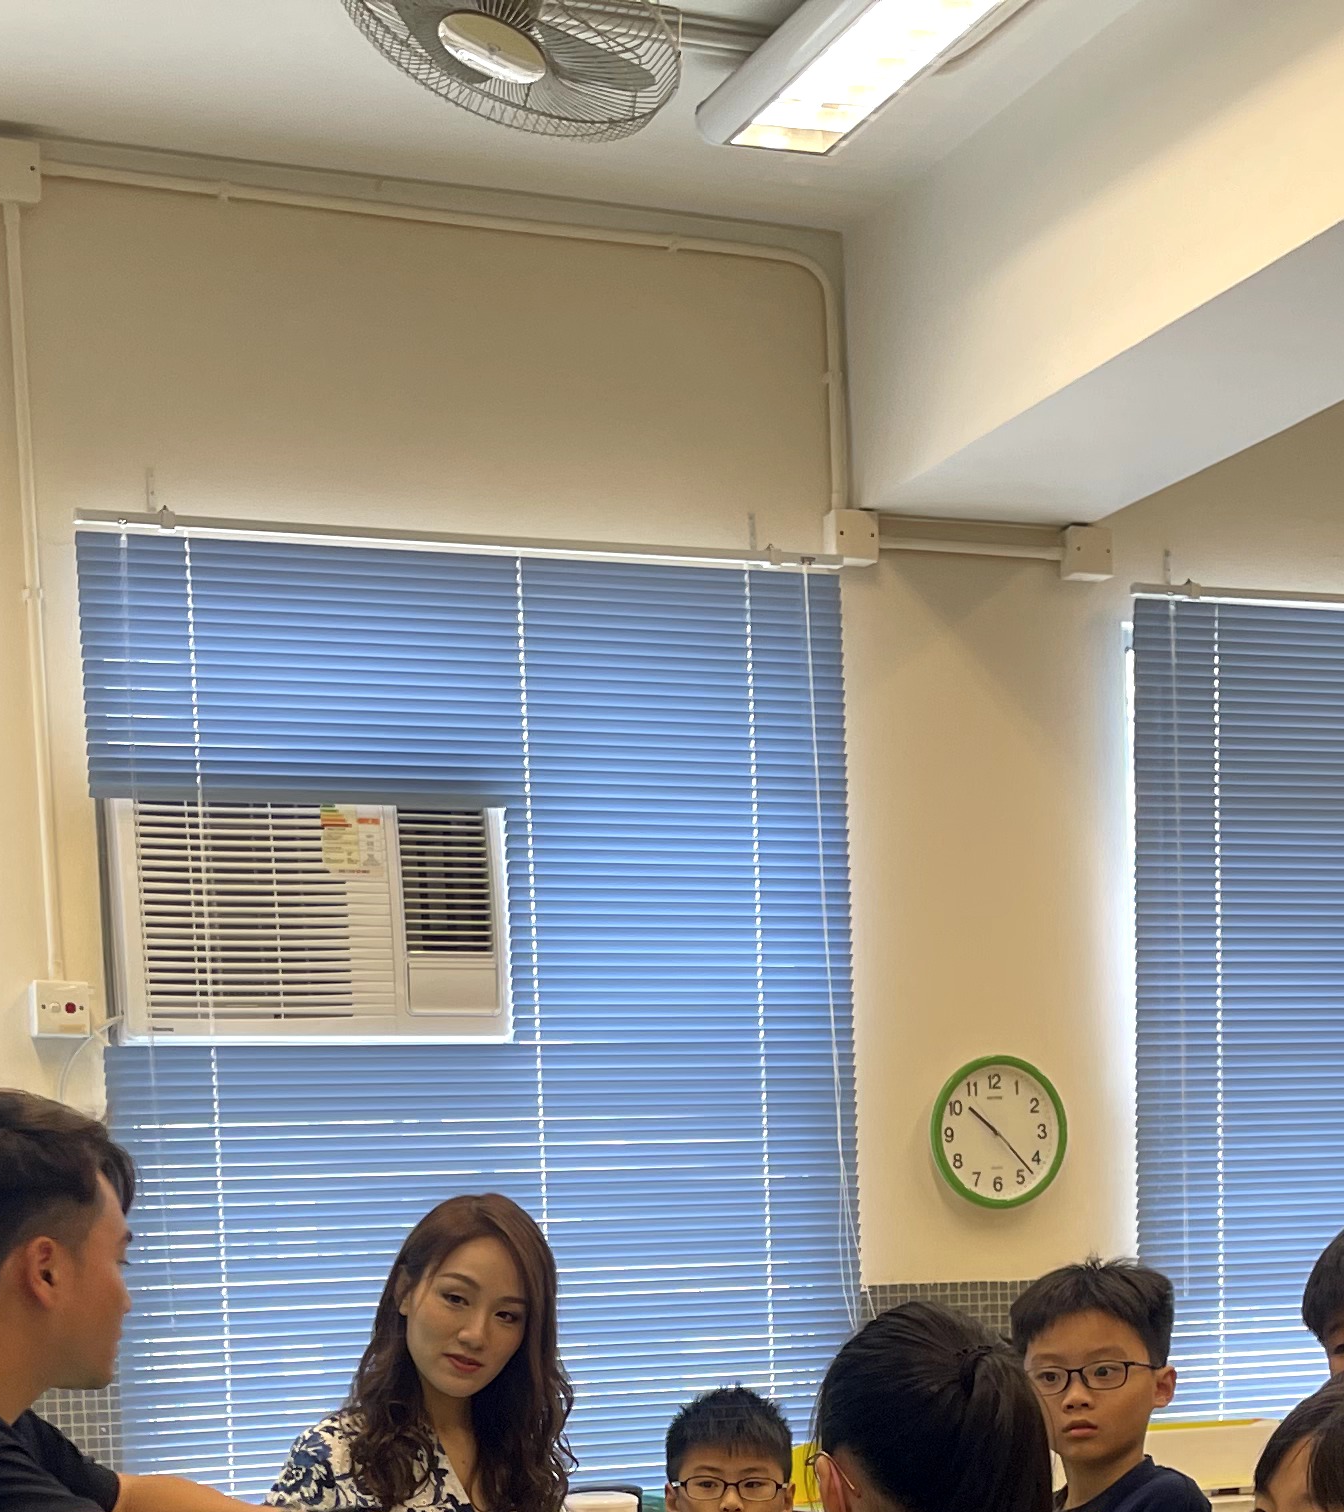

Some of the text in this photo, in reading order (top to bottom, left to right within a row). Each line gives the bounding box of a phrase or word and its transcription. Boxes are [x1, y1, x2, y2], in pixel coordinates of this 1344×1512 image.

[966, 1081, 978, 1097] 11
[987, 1073, 1002, 1090] 12
[1014, 1079, 1019, 1096] 1
[948, 1100, 963, 1116] 10
[1029, 1097, 1040, 1114] 2
[944, 1126, 954, 1143] 9
[1037, 1123, 1048, 1140] 3
[952, 1153, 963, 1169] 8
[1031, 1150, 1042, 1165] 4
[972, 1171, 982, 1187] 7
[992, 1176, 1003, 1192] 6
[1016, 1169, 1026, 1185] 5
